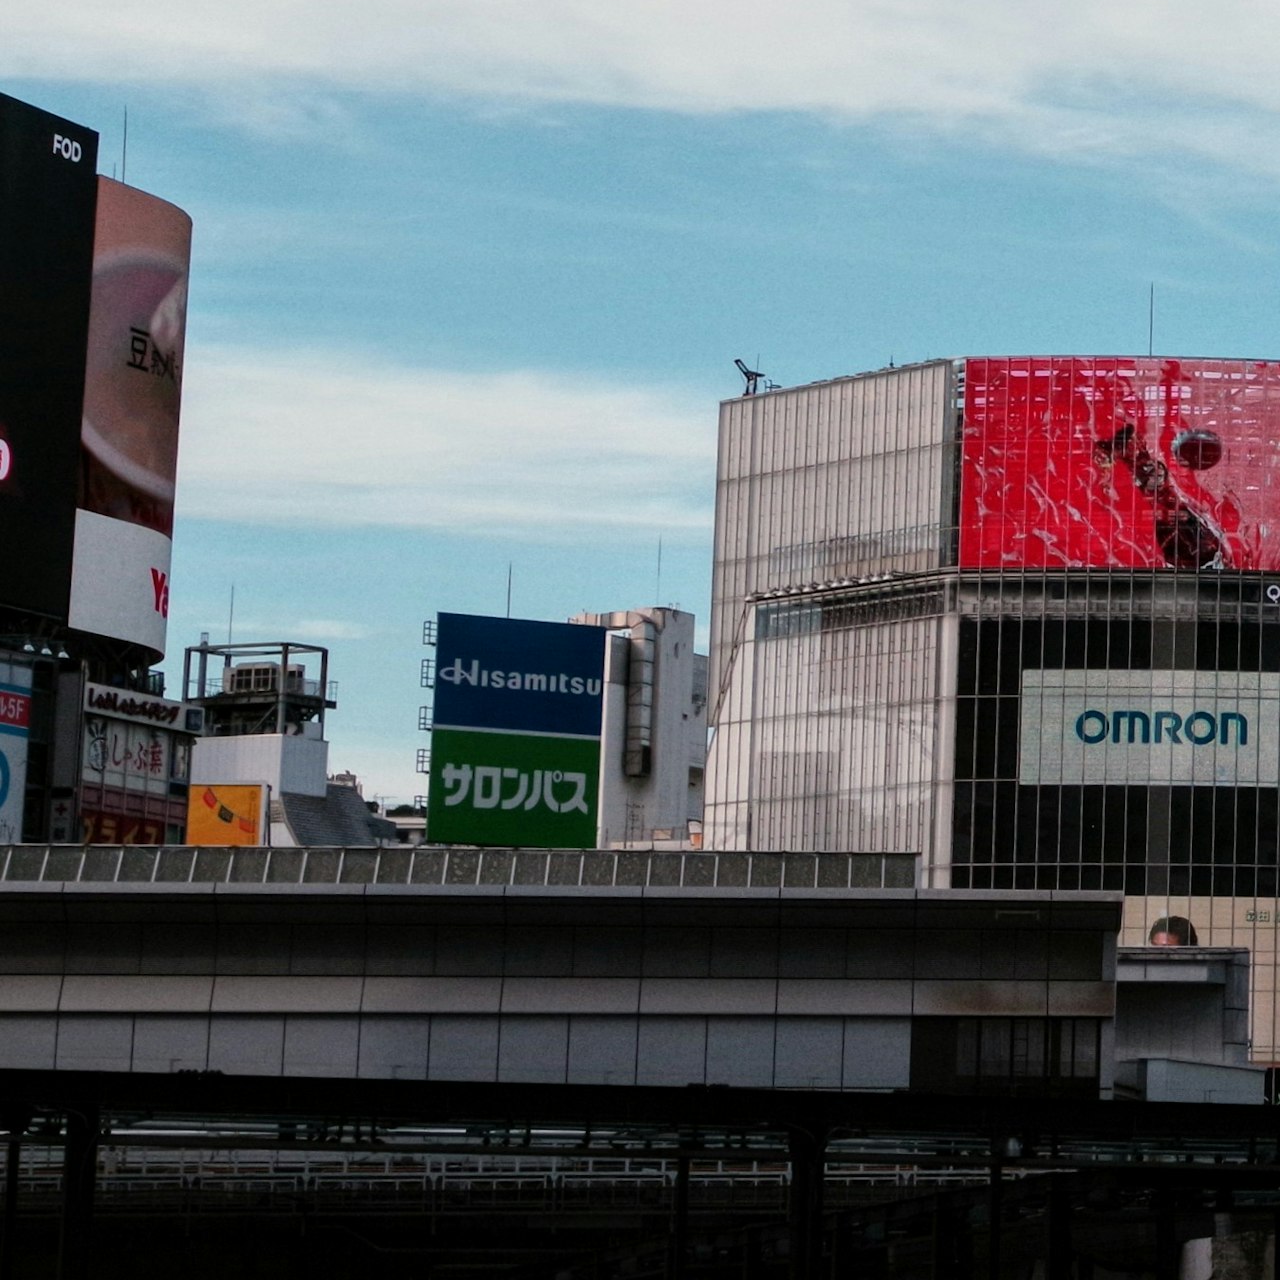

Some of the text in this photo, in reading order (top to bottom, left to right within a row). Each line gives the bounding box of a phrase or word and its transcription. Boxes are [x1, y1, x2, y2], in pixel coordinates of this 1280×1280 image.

[53, 134, 82, 162] FOD
[439, 658, 601, 696] Hisamitsu
[442, 763, 589, 815] サロンパス
